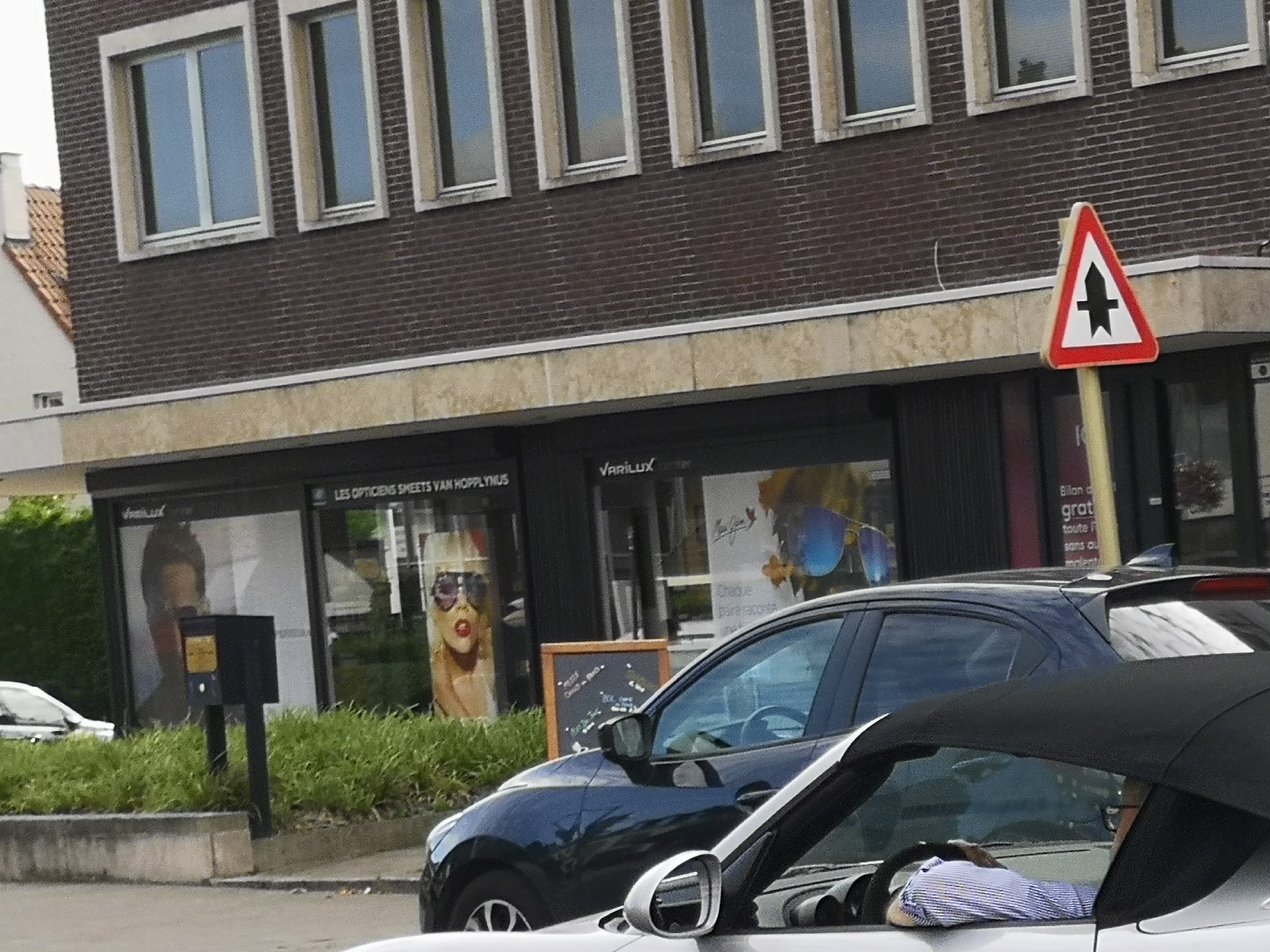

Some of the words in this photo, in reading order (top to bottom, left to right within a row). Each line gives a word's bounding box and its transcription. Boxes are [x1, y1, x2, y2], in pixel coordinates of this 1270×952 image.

[599, 457, 656, 477] VARILUX
[334, 489, 350, 501] LES
[351, 484, 397, 499] OPTICIENS
[397, 481, 432, 495] SMEETS
[434, 479, 453, 492] VAN
[454, 473, 509, 489] HOPPLYNUS
[1060, 485, 1084, 497] Bilan
[1061, 501, 1095, 522] grat
[1062, 522, 1088, 534] toute
[1064, 541, 1085, 552] sans
